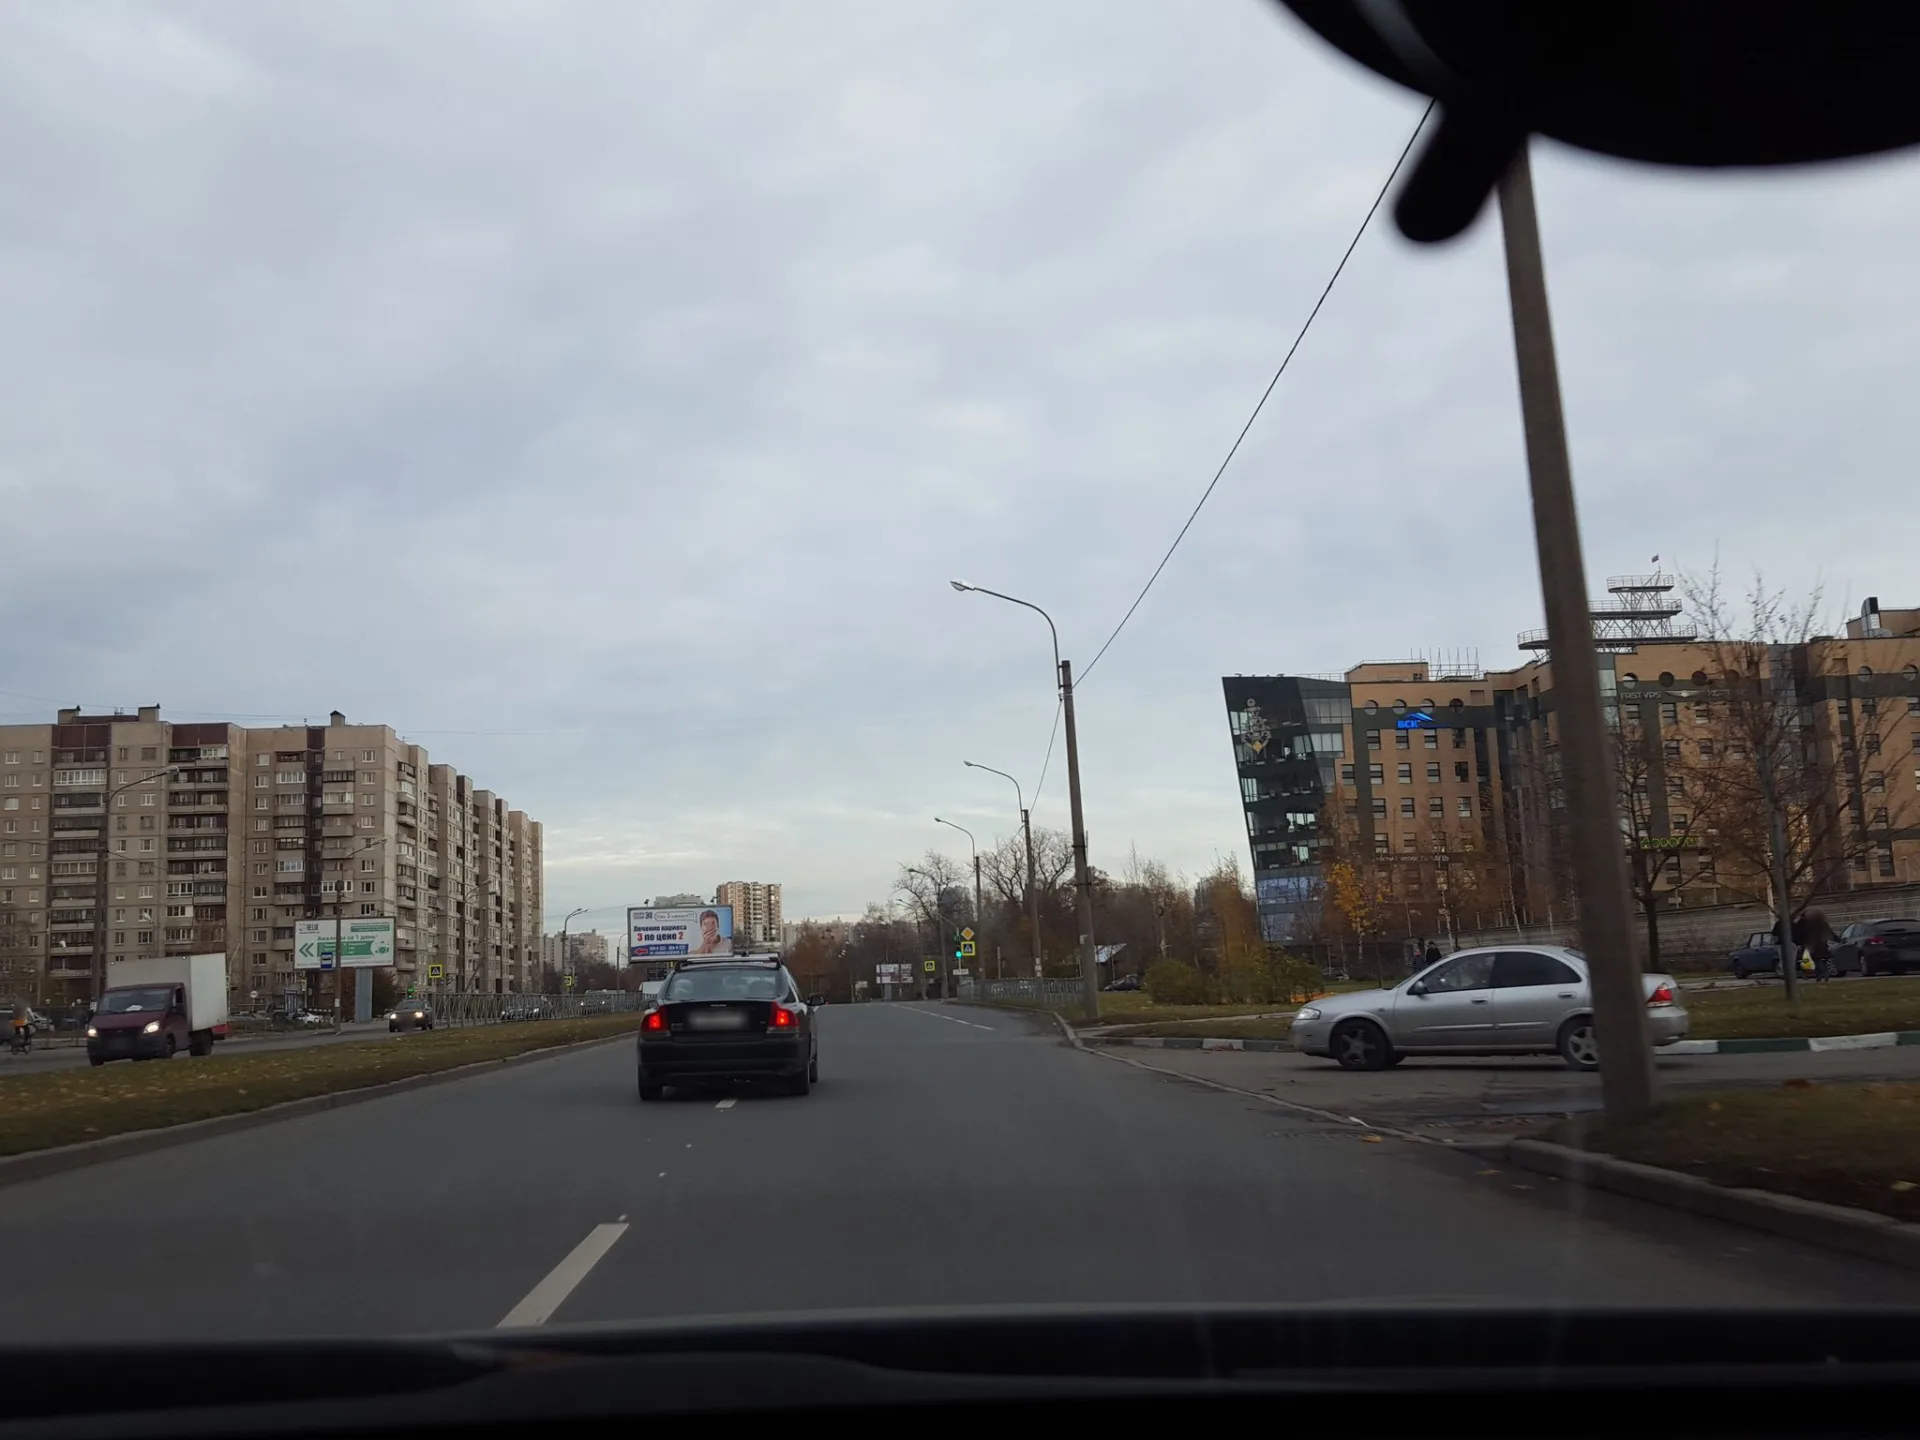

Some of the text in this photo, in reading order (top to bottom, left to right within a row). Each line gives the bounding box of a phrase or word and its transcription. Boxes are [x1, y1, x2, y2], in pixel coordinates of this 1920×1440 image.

[637, 931, 684, 942] 3 по цене 2
